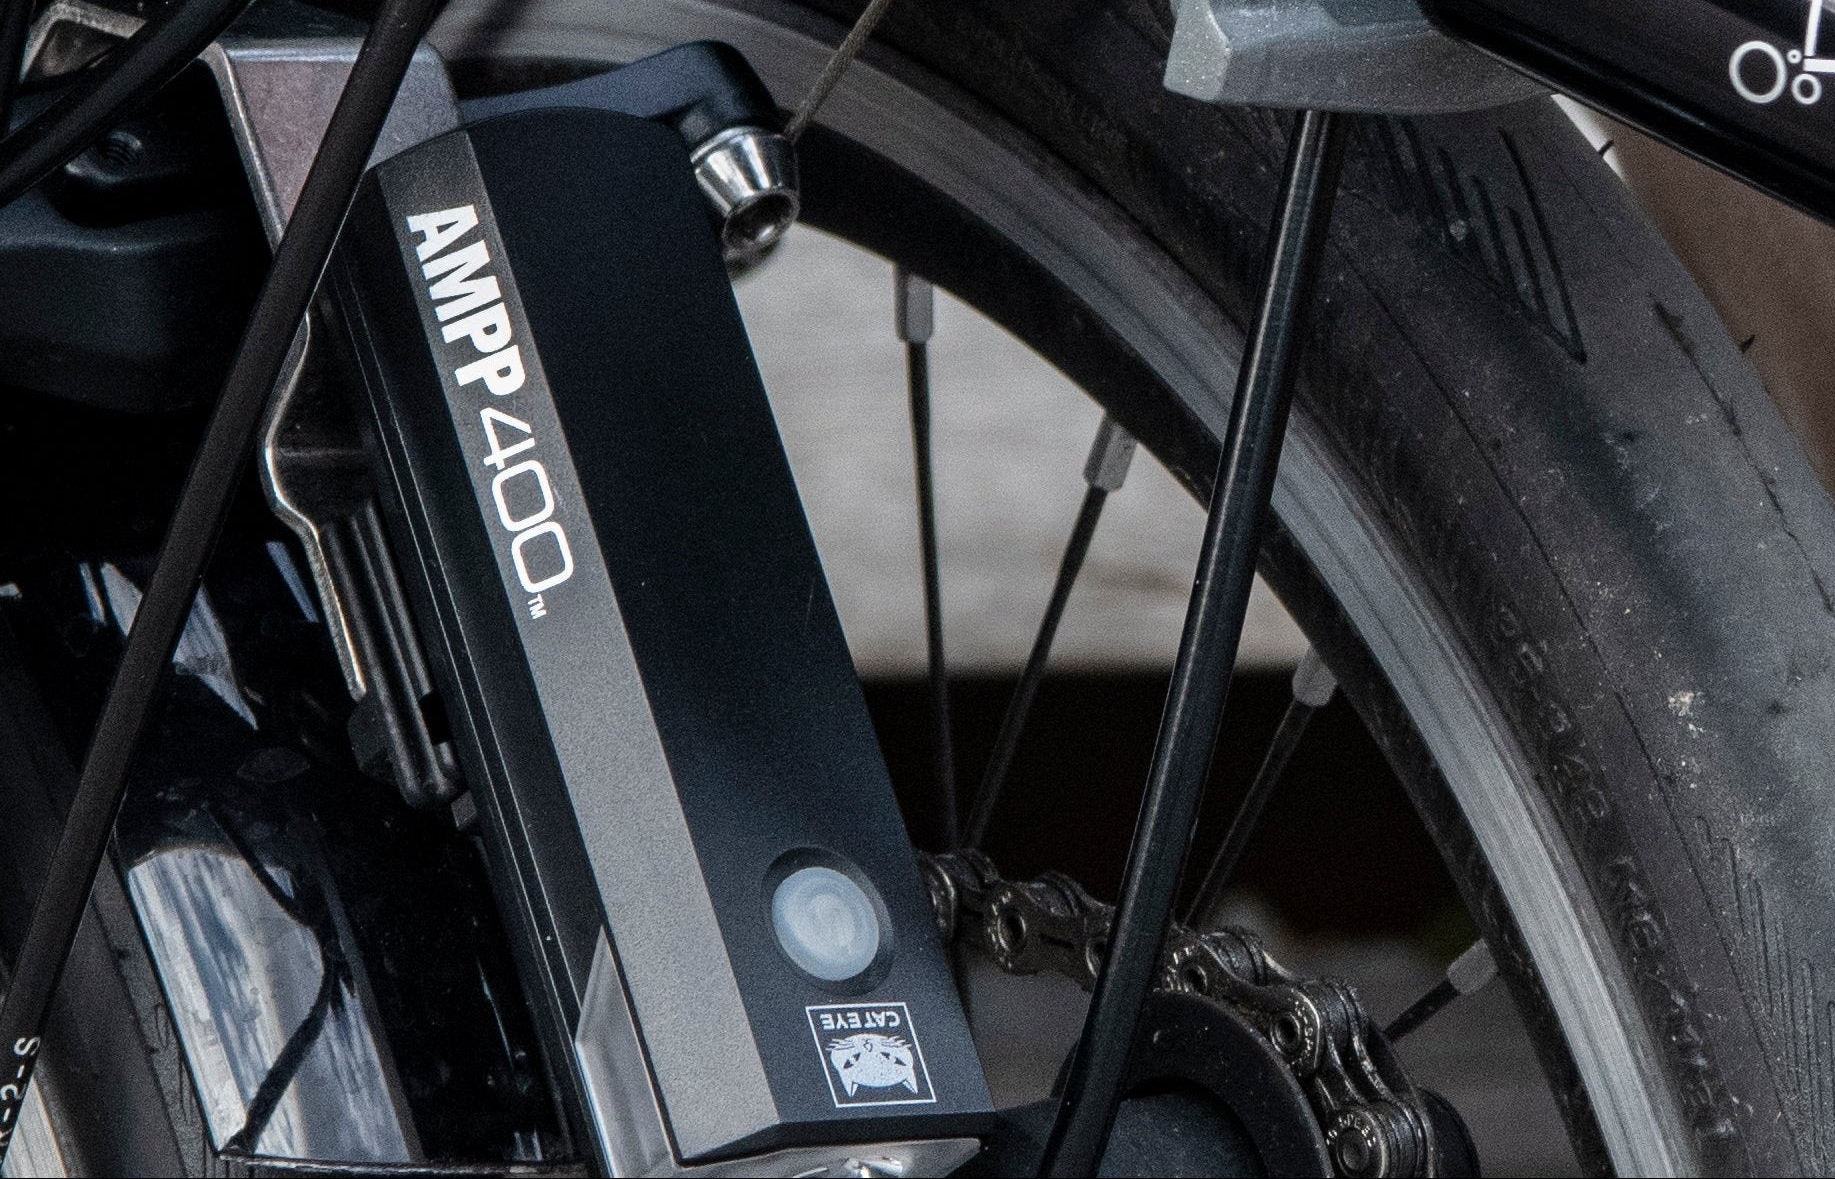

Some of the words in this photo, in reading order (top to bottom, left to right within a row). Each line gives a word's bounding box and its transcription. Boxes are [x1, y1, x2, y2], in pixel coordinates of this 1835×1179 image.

[406, 204, 526, 397] AMPP
[480, 407, 574, 594] 400
[820, 1010, 901, 1031] CATEYE
